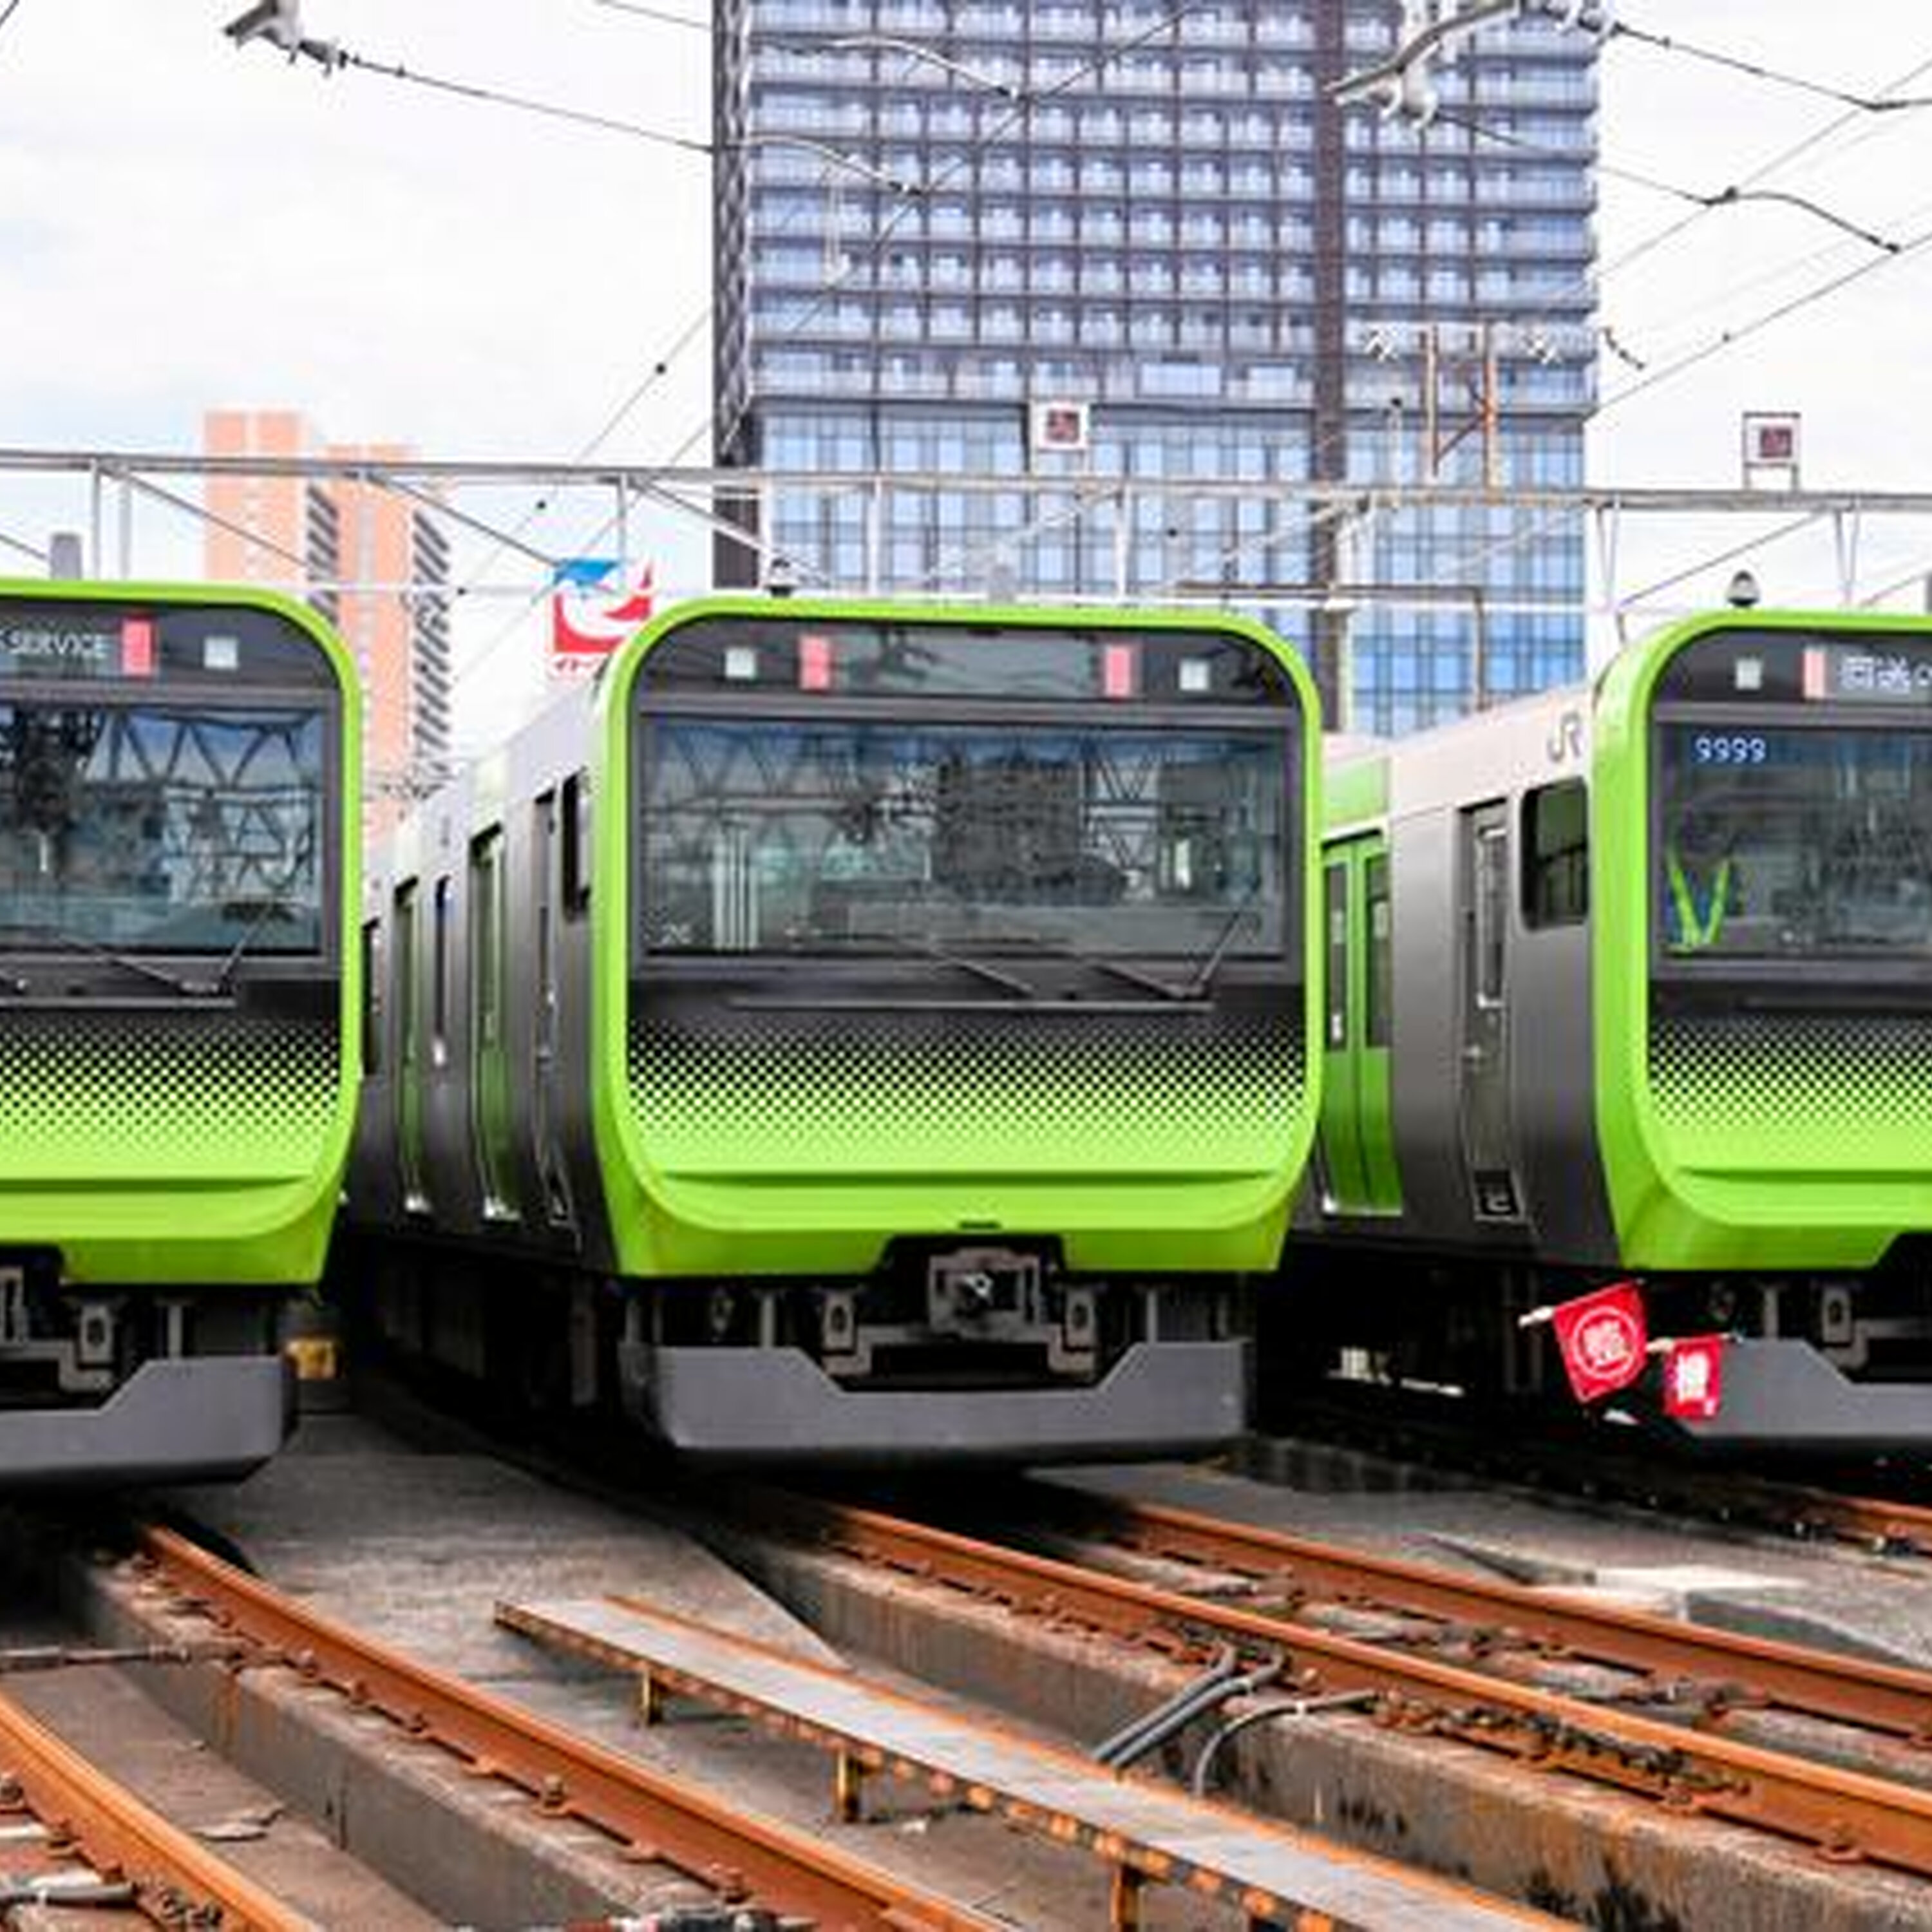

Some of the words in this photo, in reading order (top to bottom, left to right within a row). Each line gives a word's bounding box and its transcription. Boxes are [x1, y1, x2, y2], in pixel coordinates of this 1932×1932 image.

[9, 630, 107, 658] SERVICE
[1546, 712, 1582, 763] JR
[1695, 737, 1766, 763] 9999
